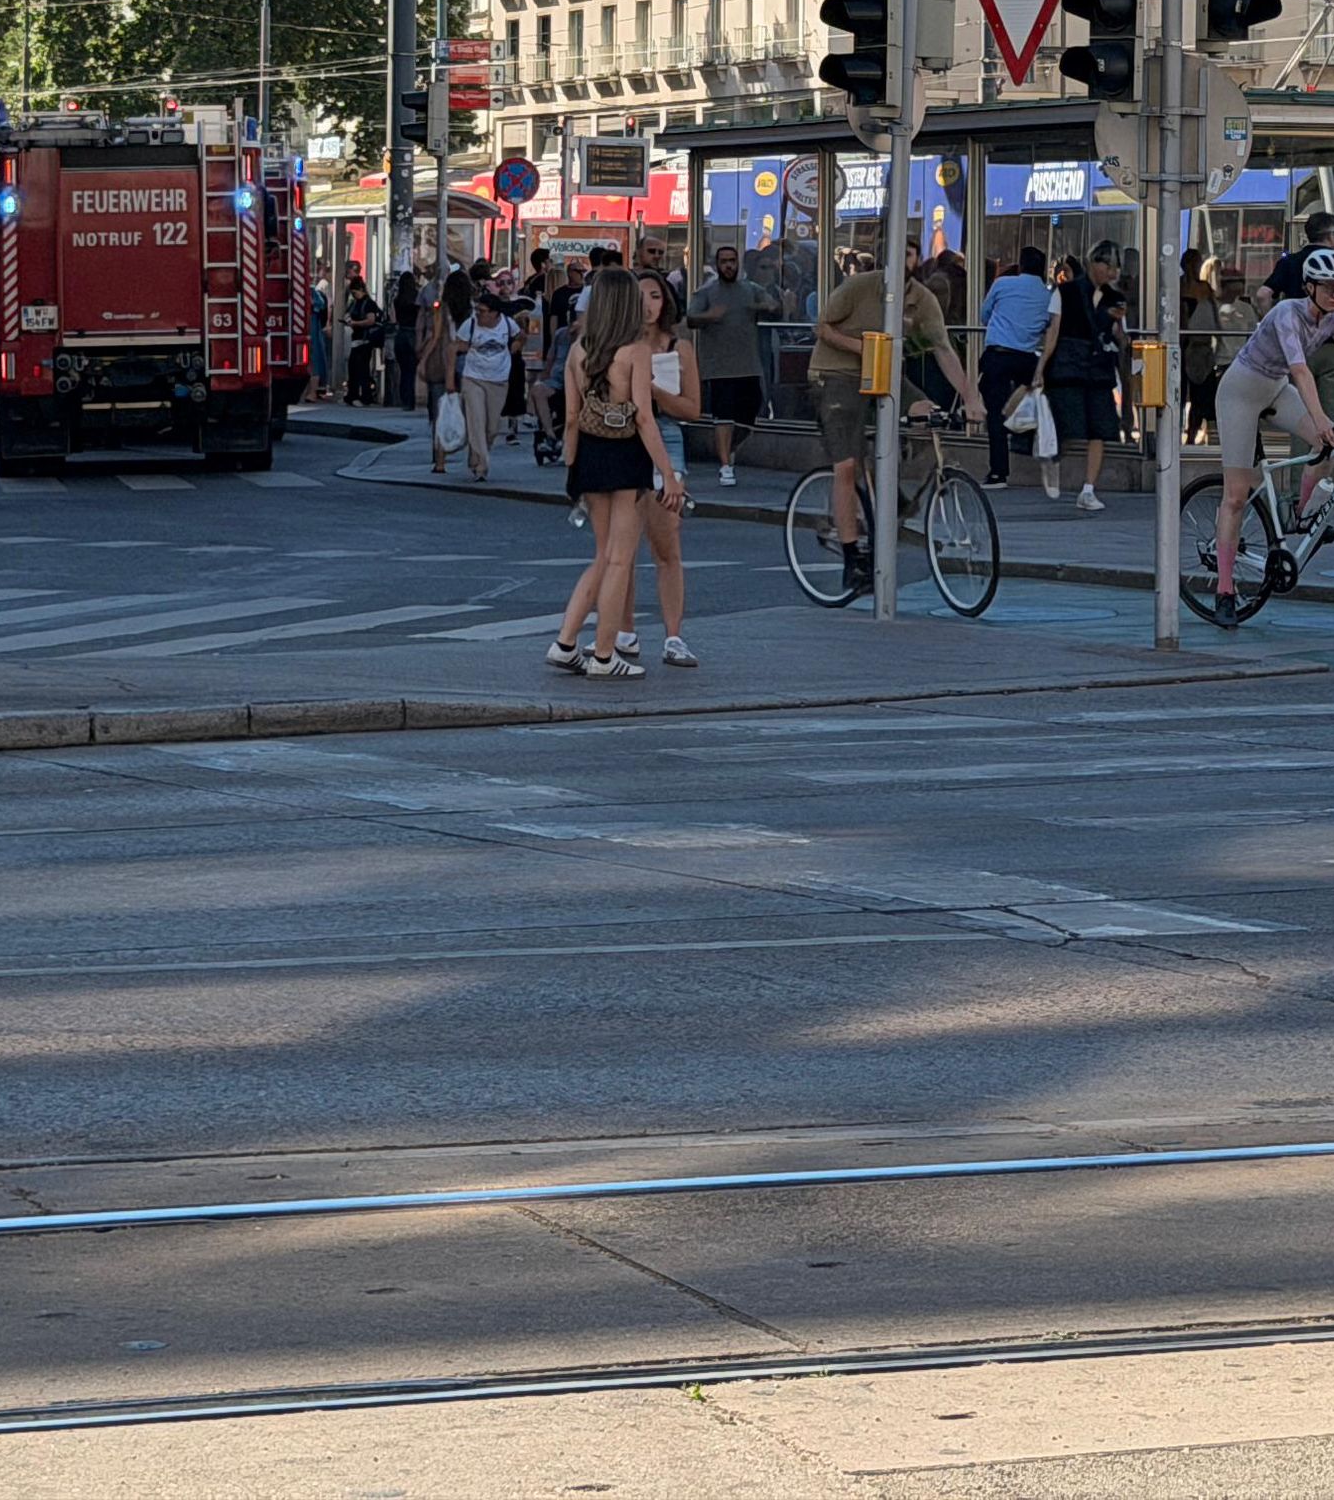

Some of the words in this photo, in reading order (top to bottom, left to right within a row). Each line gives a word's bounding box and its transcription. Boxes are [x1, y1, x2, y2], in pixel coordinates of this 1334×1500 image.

[72, 188, 188, 214] FEUERWEHR
[73, 231, 143, 248] NOTRUF
[152, 221, 188, 246] 122
[213, 313, 233, 328] 63
